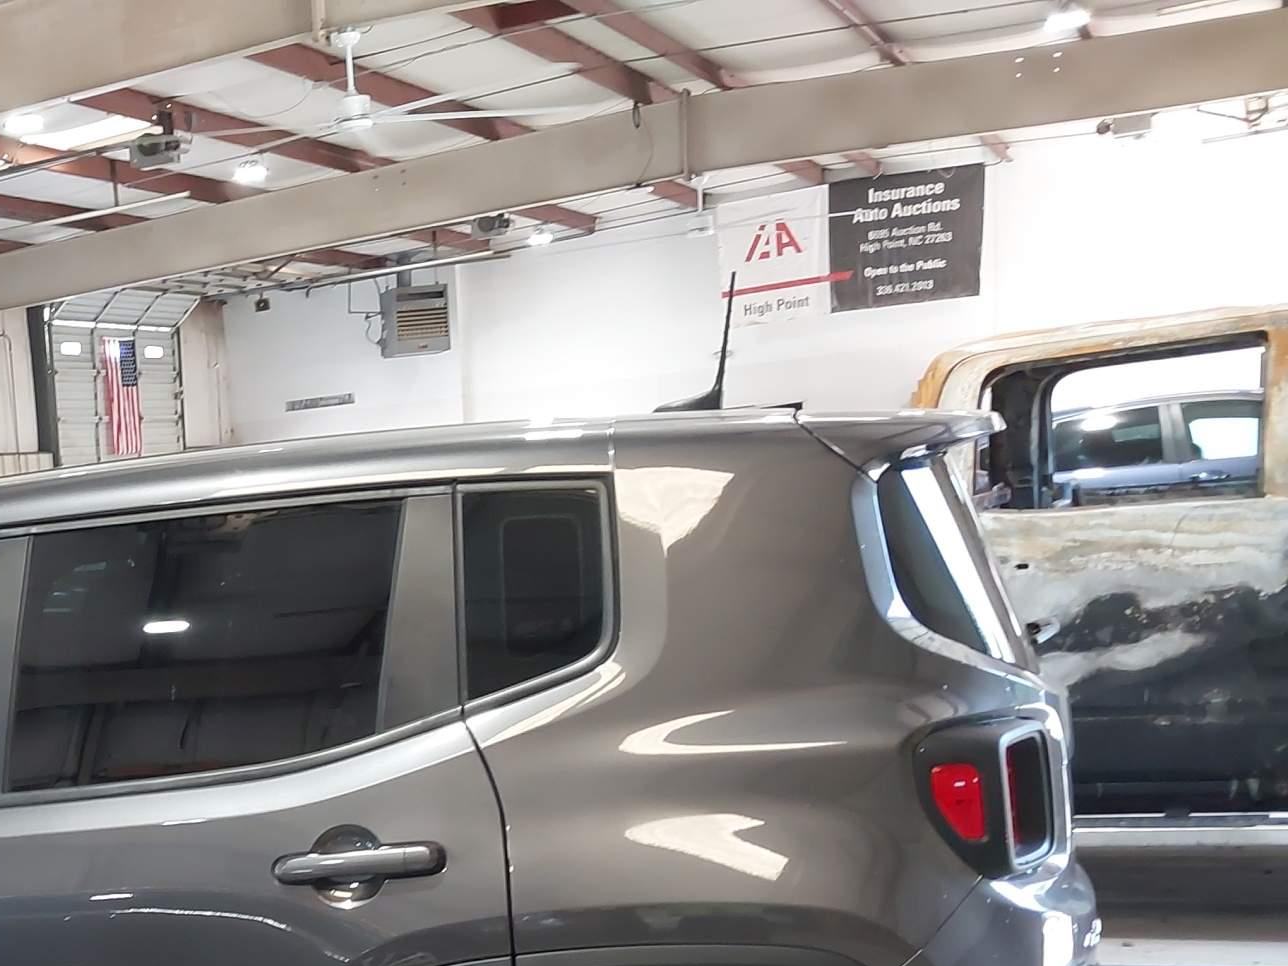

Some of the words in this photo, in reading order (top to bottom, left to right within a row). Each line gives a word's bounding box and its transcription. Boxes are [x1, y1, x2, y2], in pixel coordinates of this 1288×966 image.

[867, 181, 945, 204] Insurance
[852, 207, 888, 224] Auto
[890, 197, 961, 218] Auctions
[891, 225, 927, 237] Auction
[859, 242, 881, 254] High
[864, 266, 888, 279] Open
[888, 265, 899, 274] to
[899, 263, 915, 273] the
[915, 258, 947, 271] Public
[744, 300, 772, 317] High
[776, 296, 810, 311] Point
